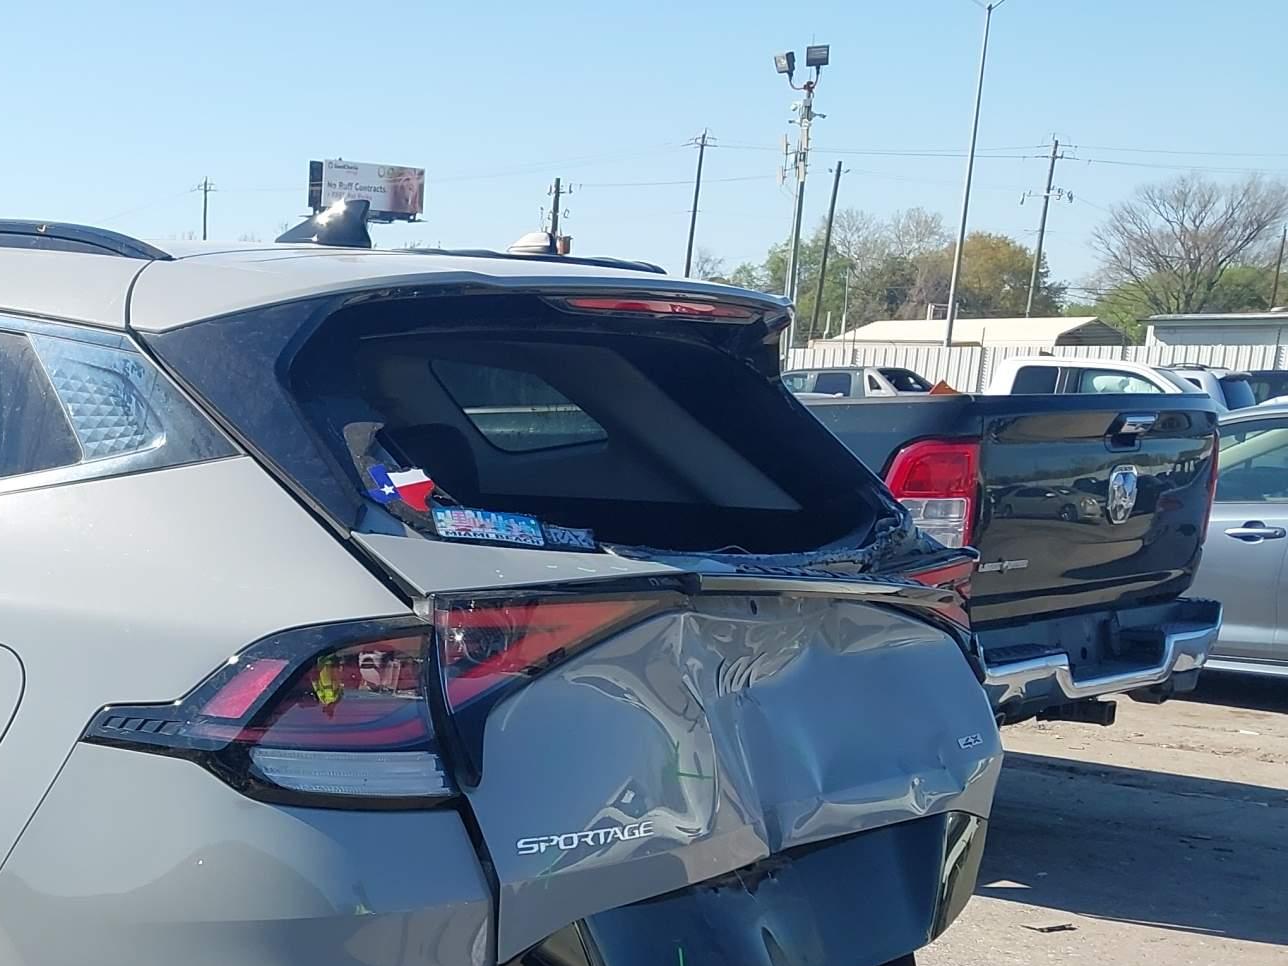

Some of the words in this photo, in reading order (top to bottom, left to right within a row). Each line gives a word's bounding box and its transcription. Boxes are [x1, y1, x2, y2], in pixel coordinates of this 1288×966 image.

[444, 530, 492, 539] MIAMI
[494, 533, 541, 546] BEACH
[516, 821, 655, 854] SPORTAGE
